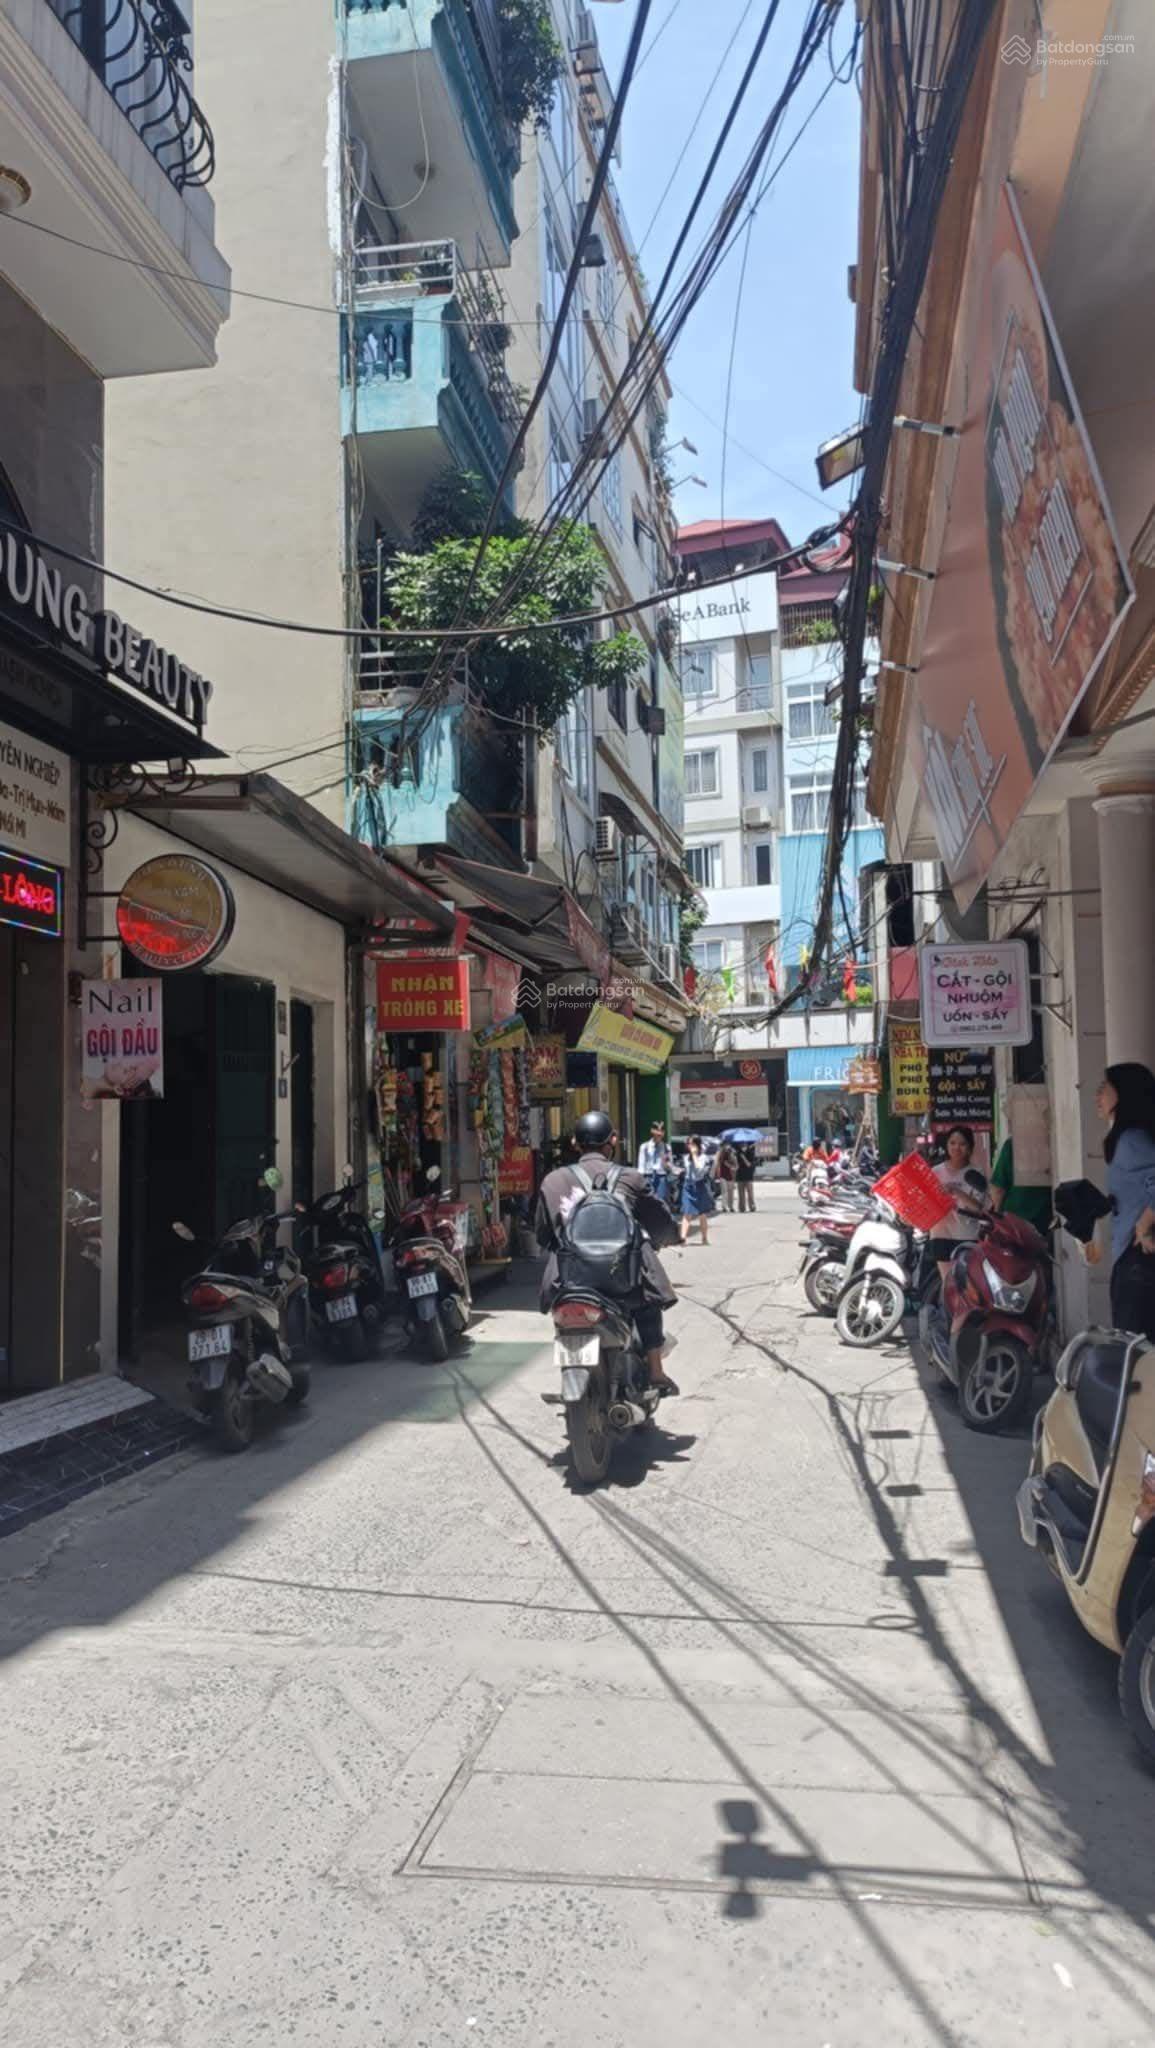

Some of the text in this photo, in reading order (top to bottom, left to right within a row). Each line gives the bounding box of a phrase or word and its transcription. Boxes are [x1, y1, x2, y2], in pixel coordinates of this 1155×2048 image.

[672, 597, 751, 622] SeABank
[0, 532, 92, 648] UNG
[103, 610, 214, 724] BEAUTY
[391, 974, 454, 994] NHẬN
[984, 970, 1012, 987] GỘI
[89, 985, 153, 1014] Nail
[947, 989, 1003, 1004] NHUỘM
[383, 997, 465, 1017] TRÔNG XE
[982, 1008, 1008, 1020] SẤY
[87, 1018, 158, 1063] GỘI ĐẦU
